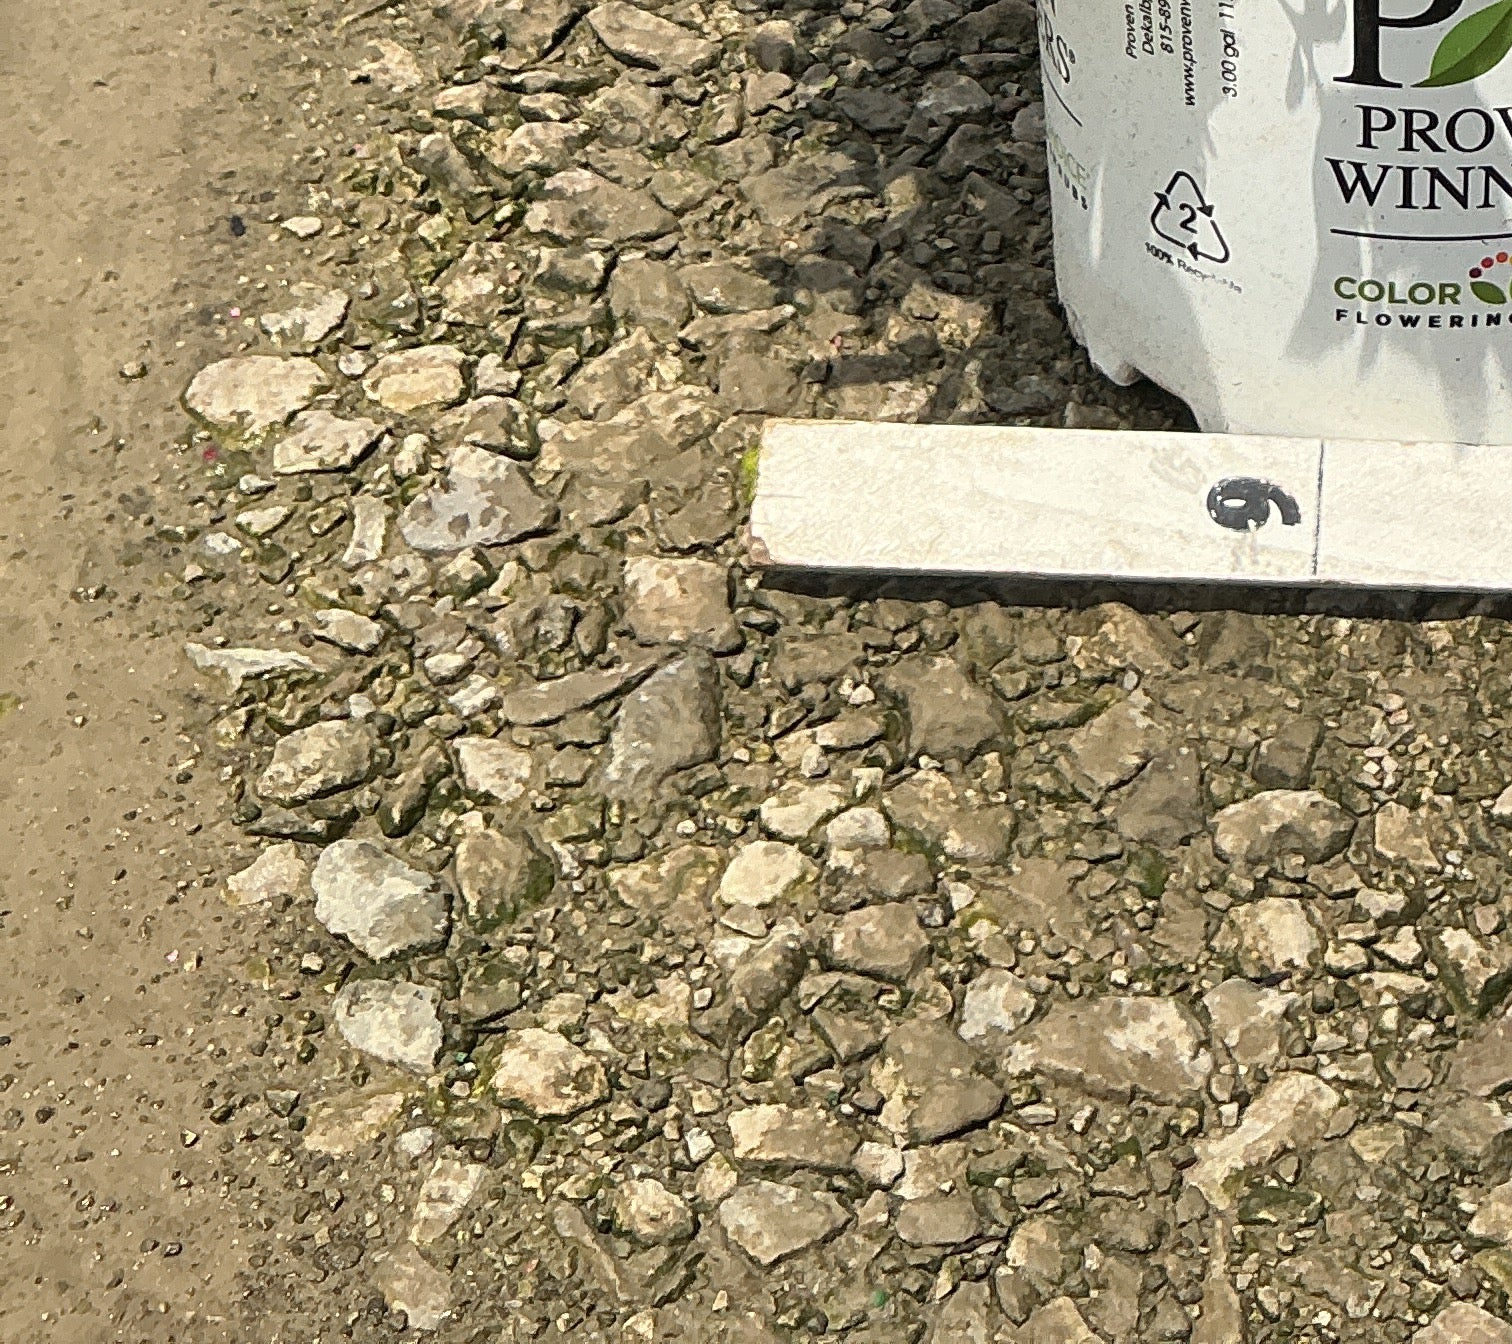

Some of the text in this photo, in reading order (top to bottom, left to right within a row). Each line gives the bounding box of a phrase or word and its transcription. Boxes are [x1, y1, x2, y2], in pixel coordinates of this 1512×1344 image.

[1123, 5, 1138, 59] Proven
[1219, 28, 1239, 59] gal
[1220, 59, 1238, 98] 3.00
[1179, 202, 1197, 234] 2
[1334, 275, 1461, 306] COLOR
[1206, 475, 1302, 533] 6
